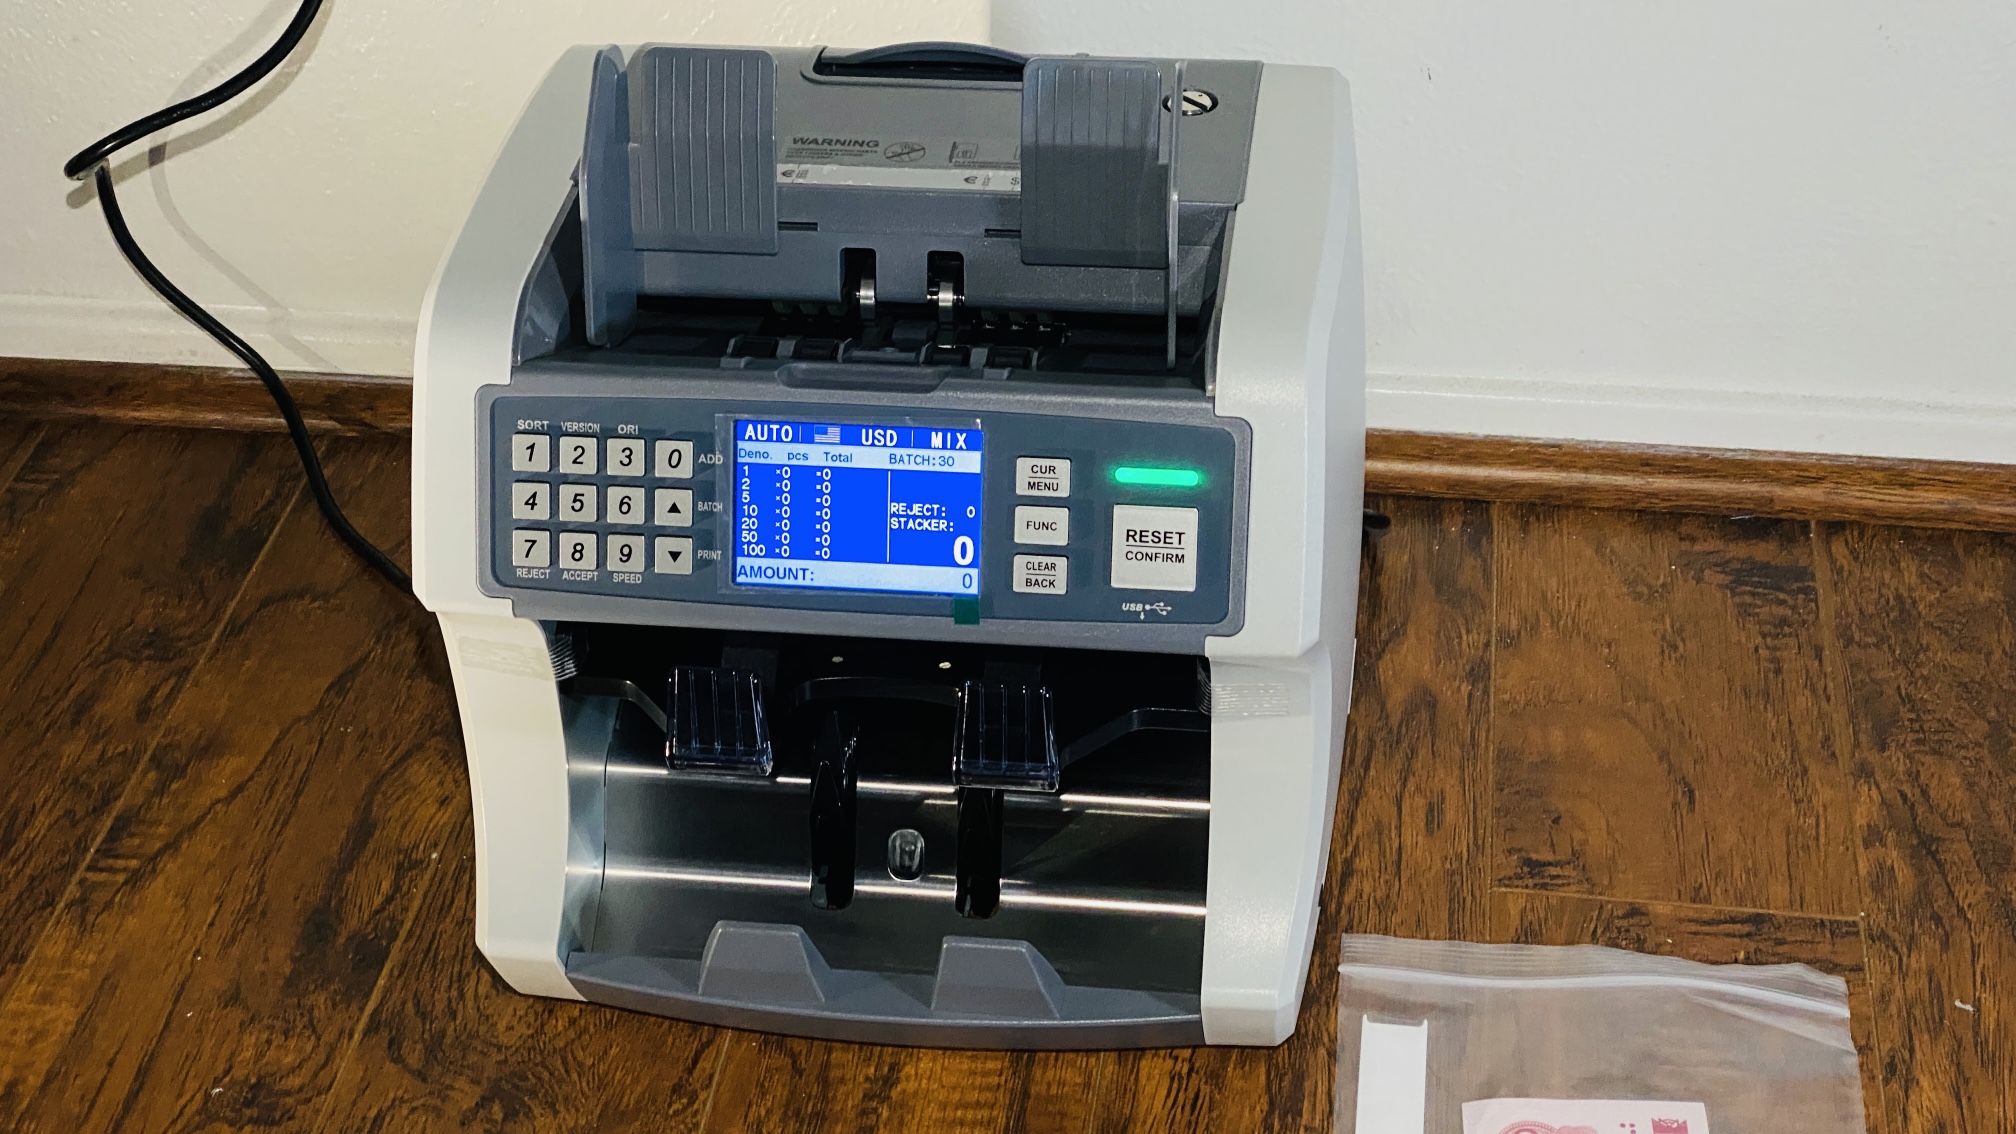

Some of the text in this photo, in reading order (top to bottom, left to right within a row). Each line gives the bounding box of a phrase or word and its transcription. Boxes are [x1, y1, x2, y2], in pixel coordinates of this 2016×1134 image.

[792, 137, 879, 148] WARNING
[517, 420, 549, 431] SORT
[561, 422, 600, 433] VERSION
[618, 425, 638, 434] ORI
[745, 424, 967, 449] AUTO USD MIX
[525, 442, 536, 462] 1
[572, 446, 585, 465] 2
[619, 447, 633, 467] 3
[738, 448, 773, 460] Deno.
[787, 452, 808, 461] pcs
[824, 452, 853, 463] Total
[668, 449, 682, 468] 0
[699, 454, 723, 464] ADD
[742, 465, 749, 477] 1
[1031, 465, 1056, 475] CUR
[741, 478, 750, 490] 2
[1028, 482, 1059, 492] MENU
[524, 491, 538, 511] 4
[741, 491, 750, 502] 5
[571, 493, 585, 512] 5
[619, 495, 632, 515] 6
[698, 502, 723, 512] BATCH
[742, 505, 758, 516] 10
[890, 503, 976, 518] REJECT: 0
[741, 518, 758, 529] 20
[890, 519, 954, 532] STACKER:
[1026, 521, 1057, 531] FUNC
[741, 531, 757, 542] 50
[1126, 529, 1185, 545] RESET
[524, 539, 537, 558] 7
[571, 543, 584, 562] 8
[619, 544, 632, 563] 9
[742, 545, 766, 556] 100
[953, 536, 974, 566] 0
[698, 551, 722, 560] PRINT
[1125, 551, 1185, 564] CONFIRM
[1026, 561, 1056, 572] CLEAR
[516, 569, 550, 579] REJECT
[562, 571, 598, 581] ACCEPT
[613, 573, 642, 583] SPEED
[738, 565, 972, 589] AMOUNT: 0
[1025, 578, 1056, 589] BACK
[1122, 603, 1143, 612] USB
